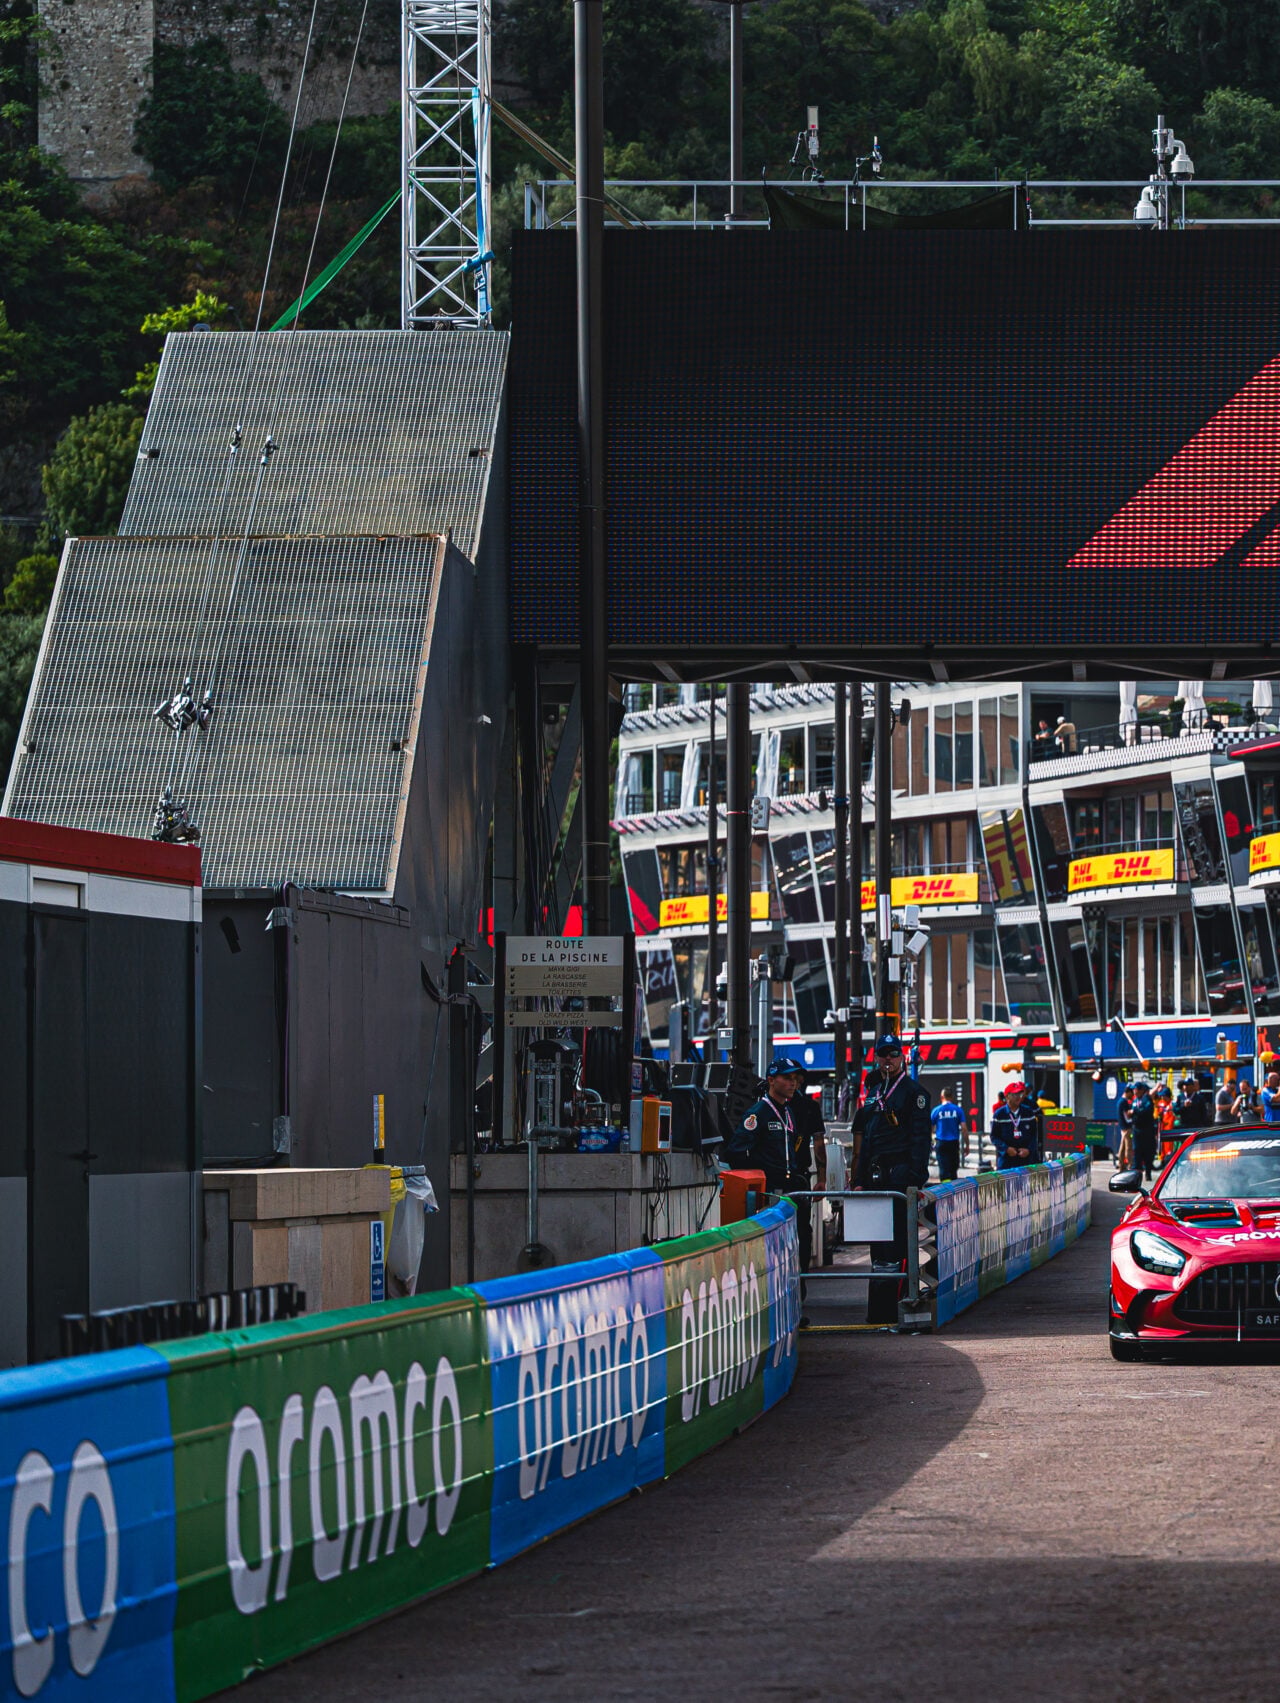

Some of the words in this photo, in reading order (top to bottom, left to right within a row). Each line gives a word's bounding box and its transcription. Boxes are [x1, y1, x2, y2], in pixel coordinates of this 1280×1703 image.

[1073, 862, 1092, 885] DHL
[1113, 855, 1152, 878] DHL
[912, 879, 955, 900] DHL
[666, 902, 688, 920] DHL
[545, 940, 584, 949] ROUTE
[522, 953, 536, 962] DE
[541, 953, 555, 962] LA
[560, 953, 608, 962] PISCINE
[679, 1261, 763, 1423] aramco
[517, 1301, 651, 1501] aramco
[227, 1355, 463, 1615] aramco
